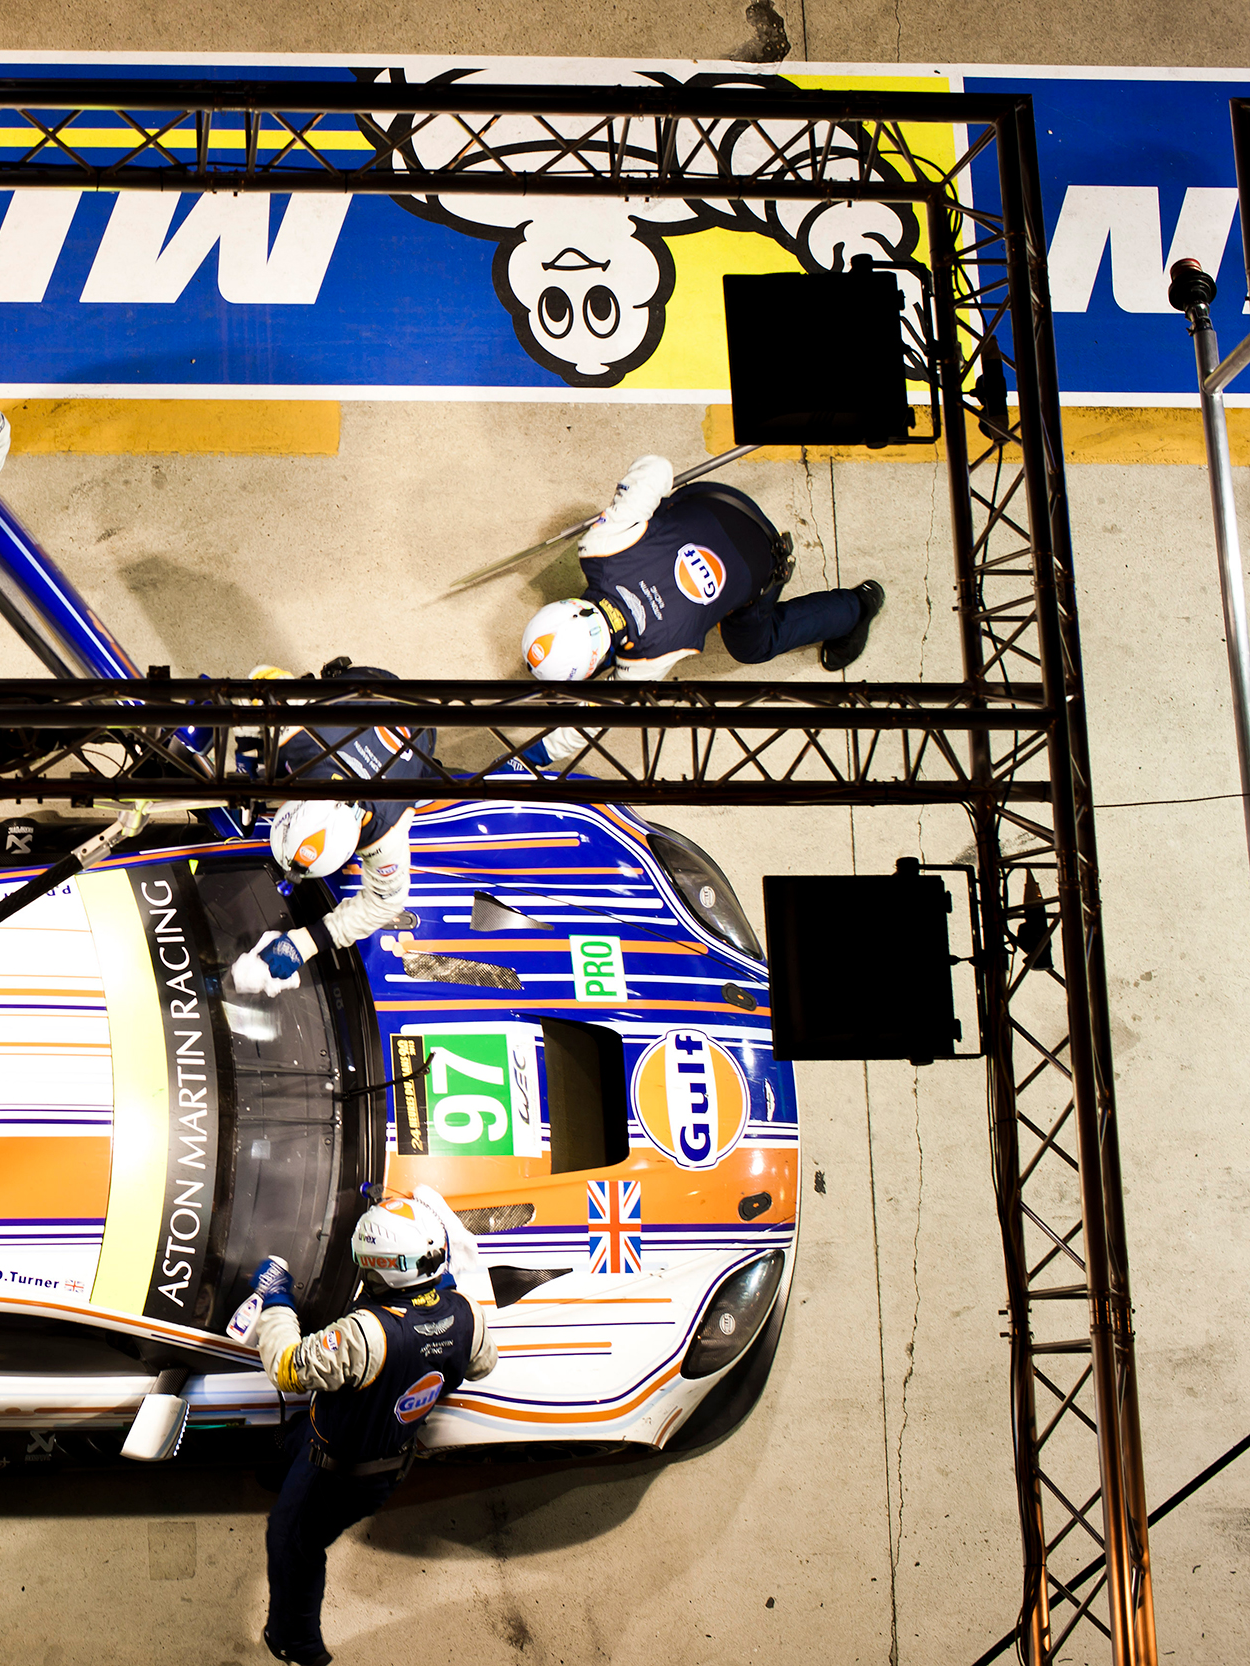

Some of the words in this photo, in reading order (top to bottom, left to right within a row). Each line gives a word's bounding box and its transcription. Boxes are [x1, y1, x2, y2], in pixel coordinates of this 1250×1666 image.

[684, 549, 717, 598] Gulf
[141, 880, 202, 1020] RACING
[580, 941, 617, 997] PRO
[173, 1030, 208, 1170] MARTIN
[405, 1095, 421, 1128] HEURES
[430, 1046, 508, 1144] 97
[512, 1050, 530, 1125] WEC
[675, 1033, 711, 1162] Gulf
[410, 1128, 423, 1152] 24
[157, 1179, 205, 1308] ASTON
[358, 1233, 377, 1245] uvex
[360, 1255, 400, 1270] uvex
